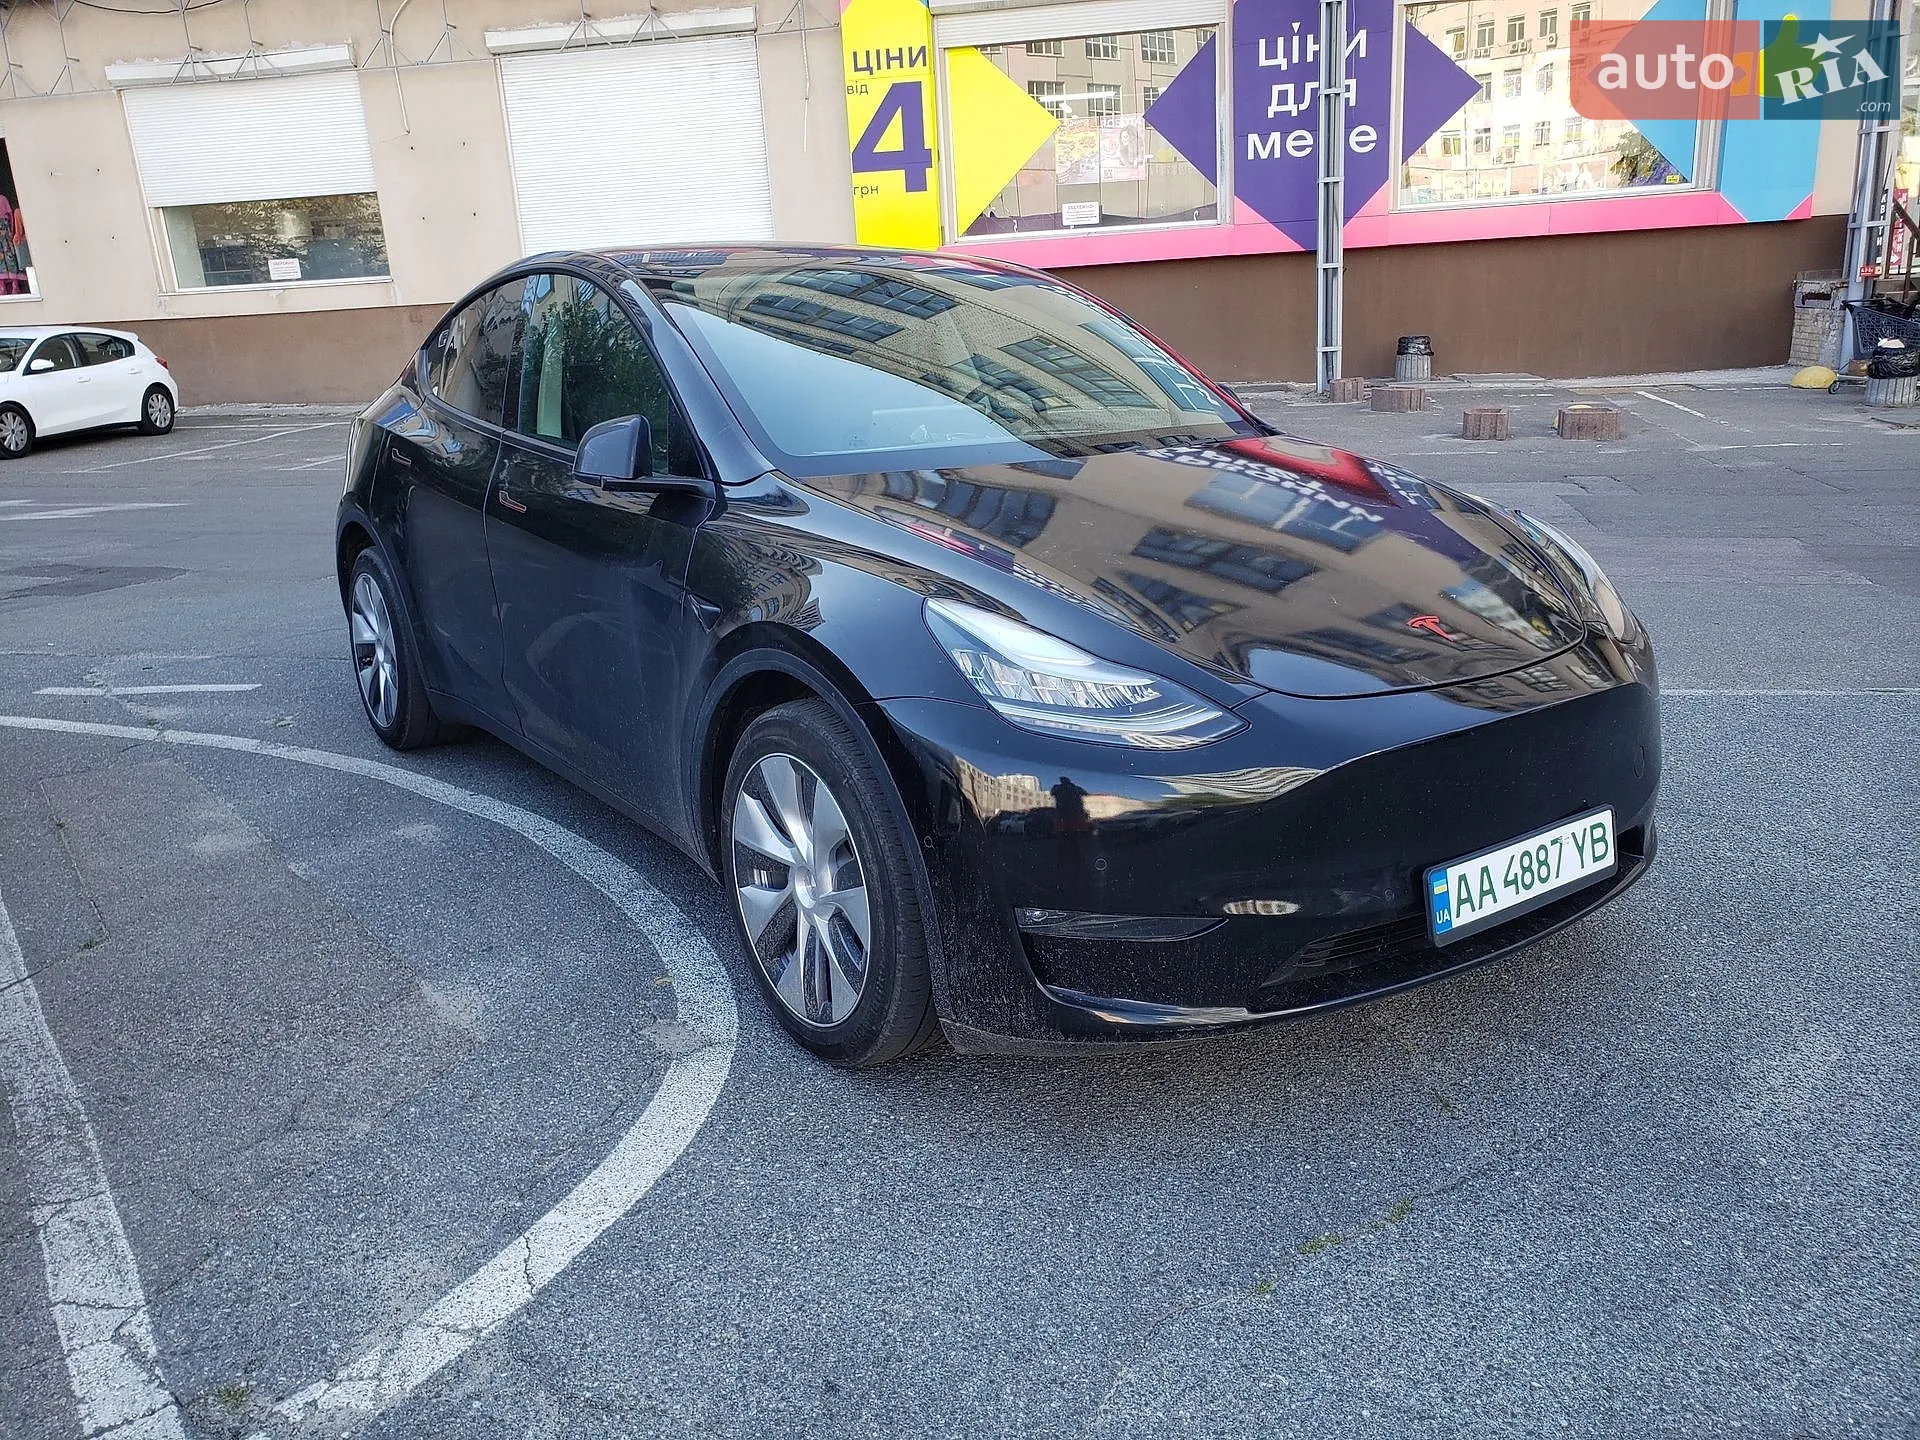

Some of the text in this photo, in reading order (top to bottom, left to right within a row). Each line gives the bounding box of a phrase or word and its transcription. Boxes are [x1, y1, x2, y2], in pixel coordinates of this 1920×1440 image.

[846, 80, 869, 96] від
[851, 81, 933, 193] 4
[1247, 124, 1378, 161] мее
[853, 184, 879, 199] грн
[1455, 821, 1609, 919] AA 4887 YB
[1435, 910, 1451, 925] UA
